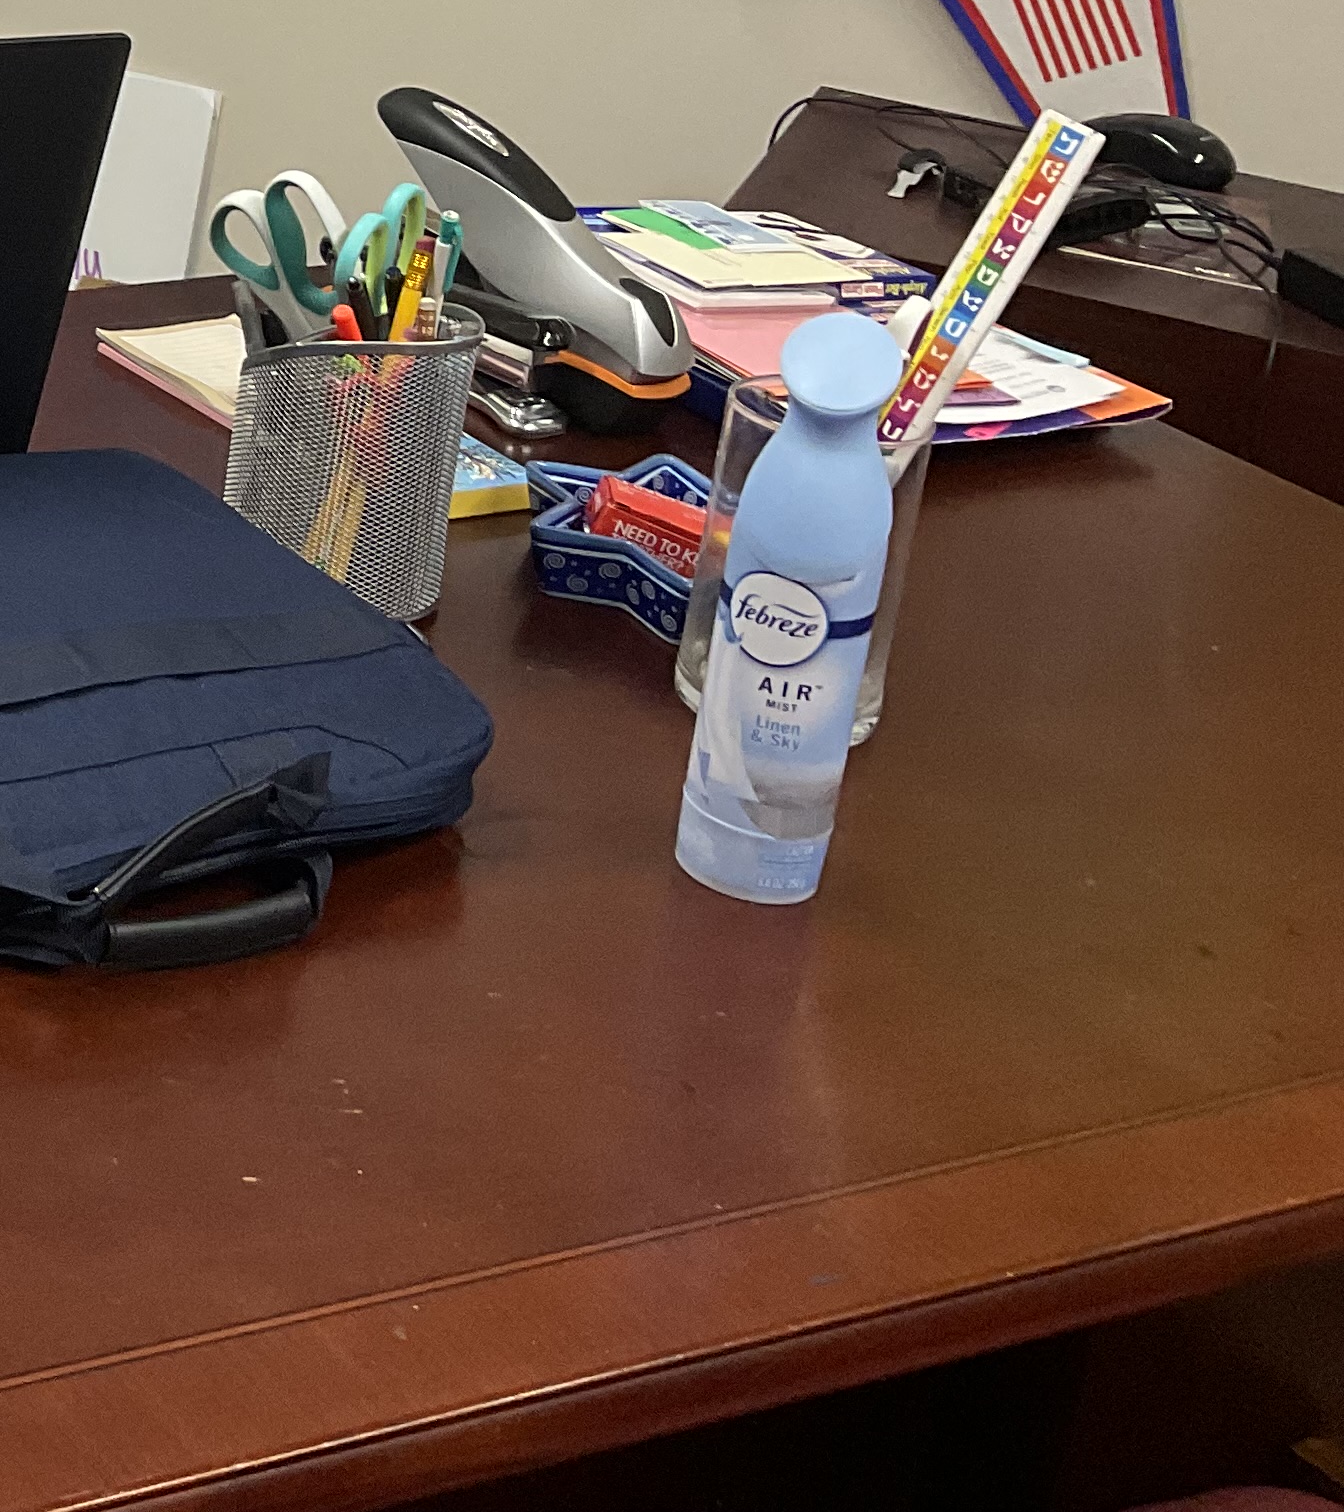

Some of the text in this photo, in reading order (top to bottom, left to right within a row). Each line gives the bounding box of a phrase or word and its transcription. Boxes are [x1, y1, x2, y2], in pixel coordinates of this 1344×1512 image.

[614, 519, 658, 547] NEED
[659, 538, 682, 557] TO
[735, 593, 818, 638] febreze
[758, 676, 813, 701] AIR
[765, 698, 798, 712] MIST
[755, 715, 801, 735] Linen
[751, 730, 801, 751] & Sky
